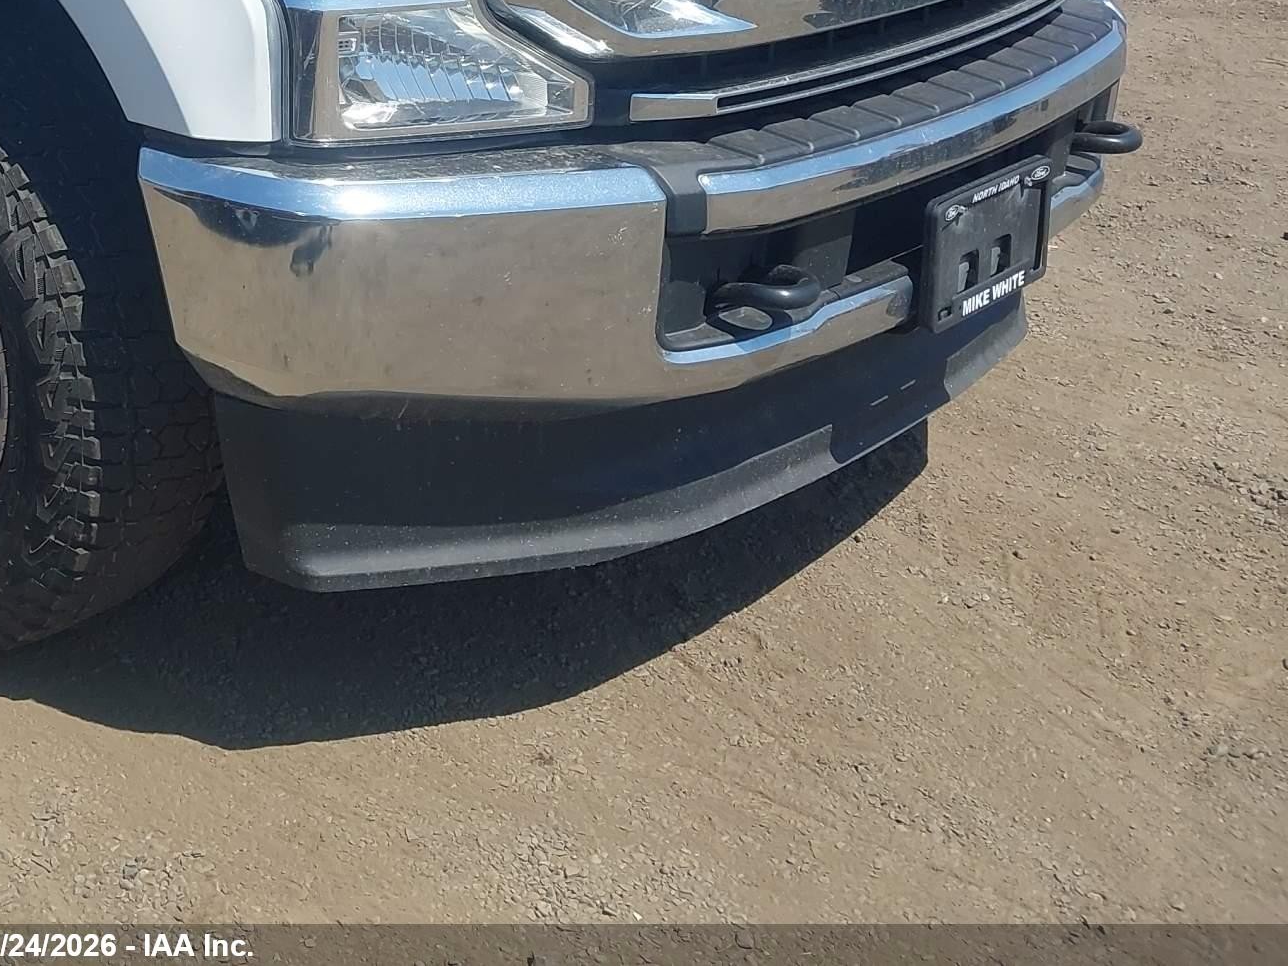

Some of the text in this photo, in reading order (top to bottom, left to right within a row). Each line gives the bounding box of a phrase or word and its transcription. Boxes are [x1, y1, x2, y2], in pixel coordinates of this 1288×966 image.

[972, 174, 1020, 204] NORTH IDAHO
[962, 270, 1025, 317] MIKE WHITE
